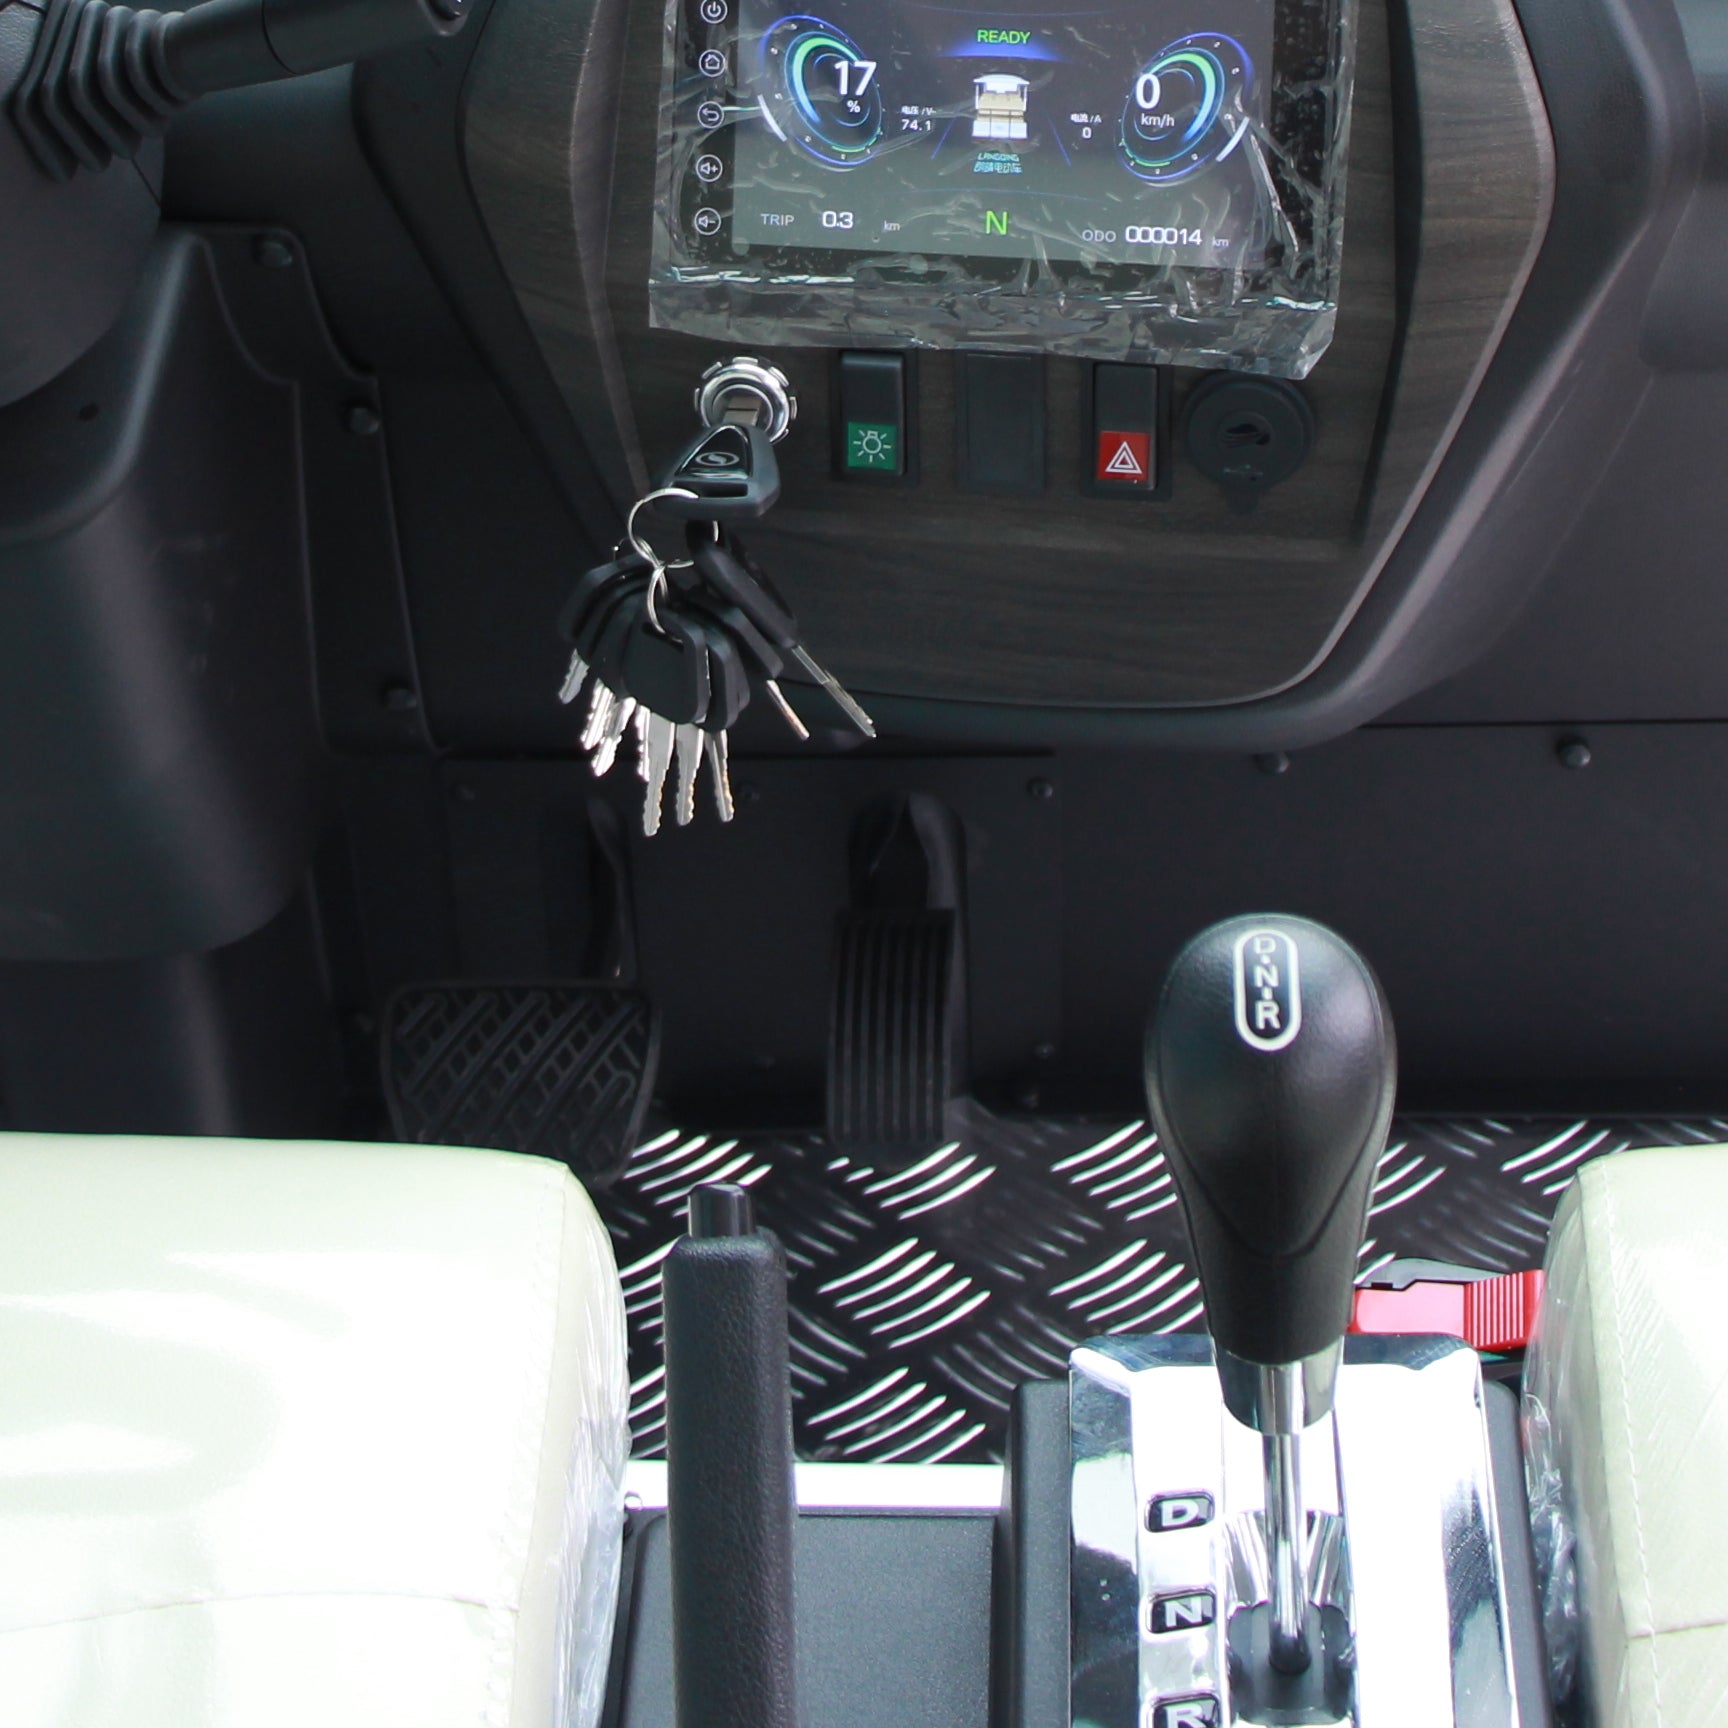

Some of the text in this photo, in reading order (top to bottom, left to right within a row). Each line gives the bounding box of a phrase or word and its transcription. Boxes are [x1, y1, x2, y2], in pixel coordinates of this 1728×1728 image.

[977, 29, 1031, 45] READY
[834, 60, 878, 97] 17
[1135, 72, 1161, 110] 0
[846, 99, 862, 114] %
[901, 118, 932, 132] 74.1
[1082, 126, 1093, 139] 0
[1140, 112, 1176, 129] km/h
[760, 210, 901, 232] TRIP 0.3 km
[984, 210, 1008, 235] N
[1082, 225, 1230, 248] ODO 000014 km
[1254, 1000, 1281, 1030] R
[1161, 1498, 1200, 1528] D
[1164, 1596, 1203, 1628] N
[1166, 1702, 1207, 1728] R
